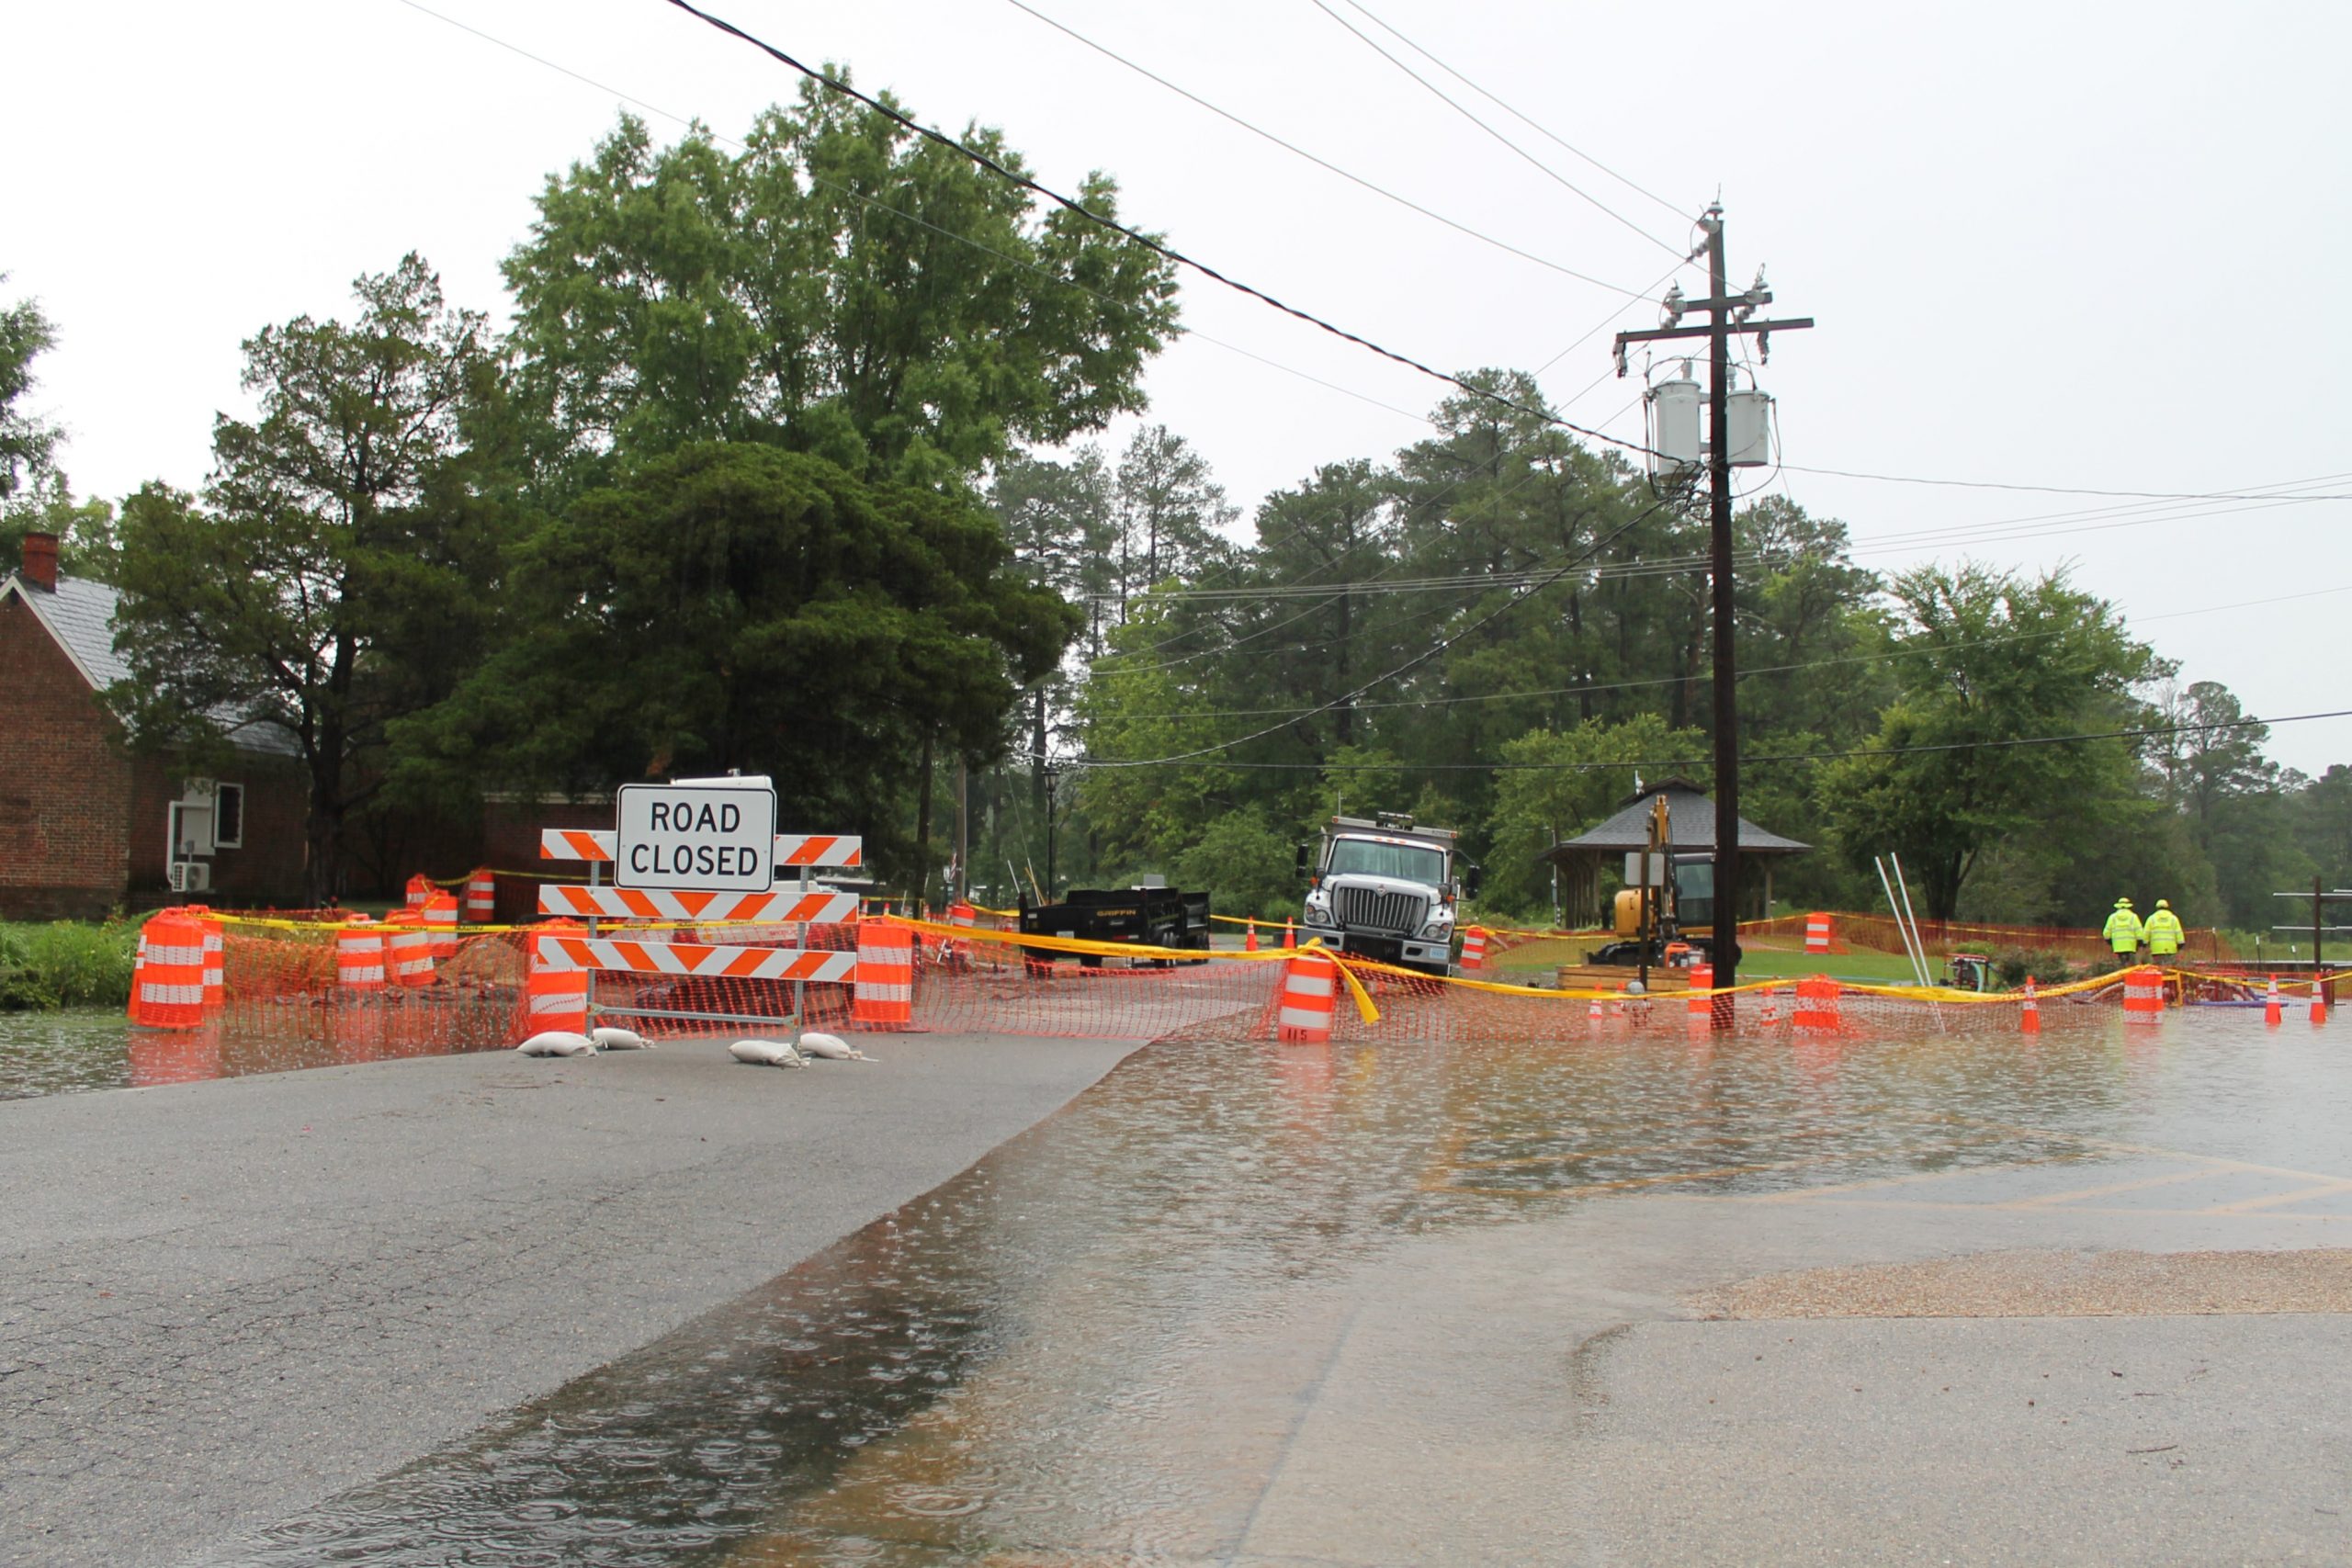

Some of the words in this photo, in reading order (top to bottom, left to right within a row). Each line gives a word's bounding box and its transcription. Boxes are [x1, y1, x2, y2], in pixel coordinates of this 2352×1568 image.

[650, 802, 741, 833] ROAD
[630, 843, 758, 877] CLOSED
[1096, 908, 1136, 918] GRIFFIN
